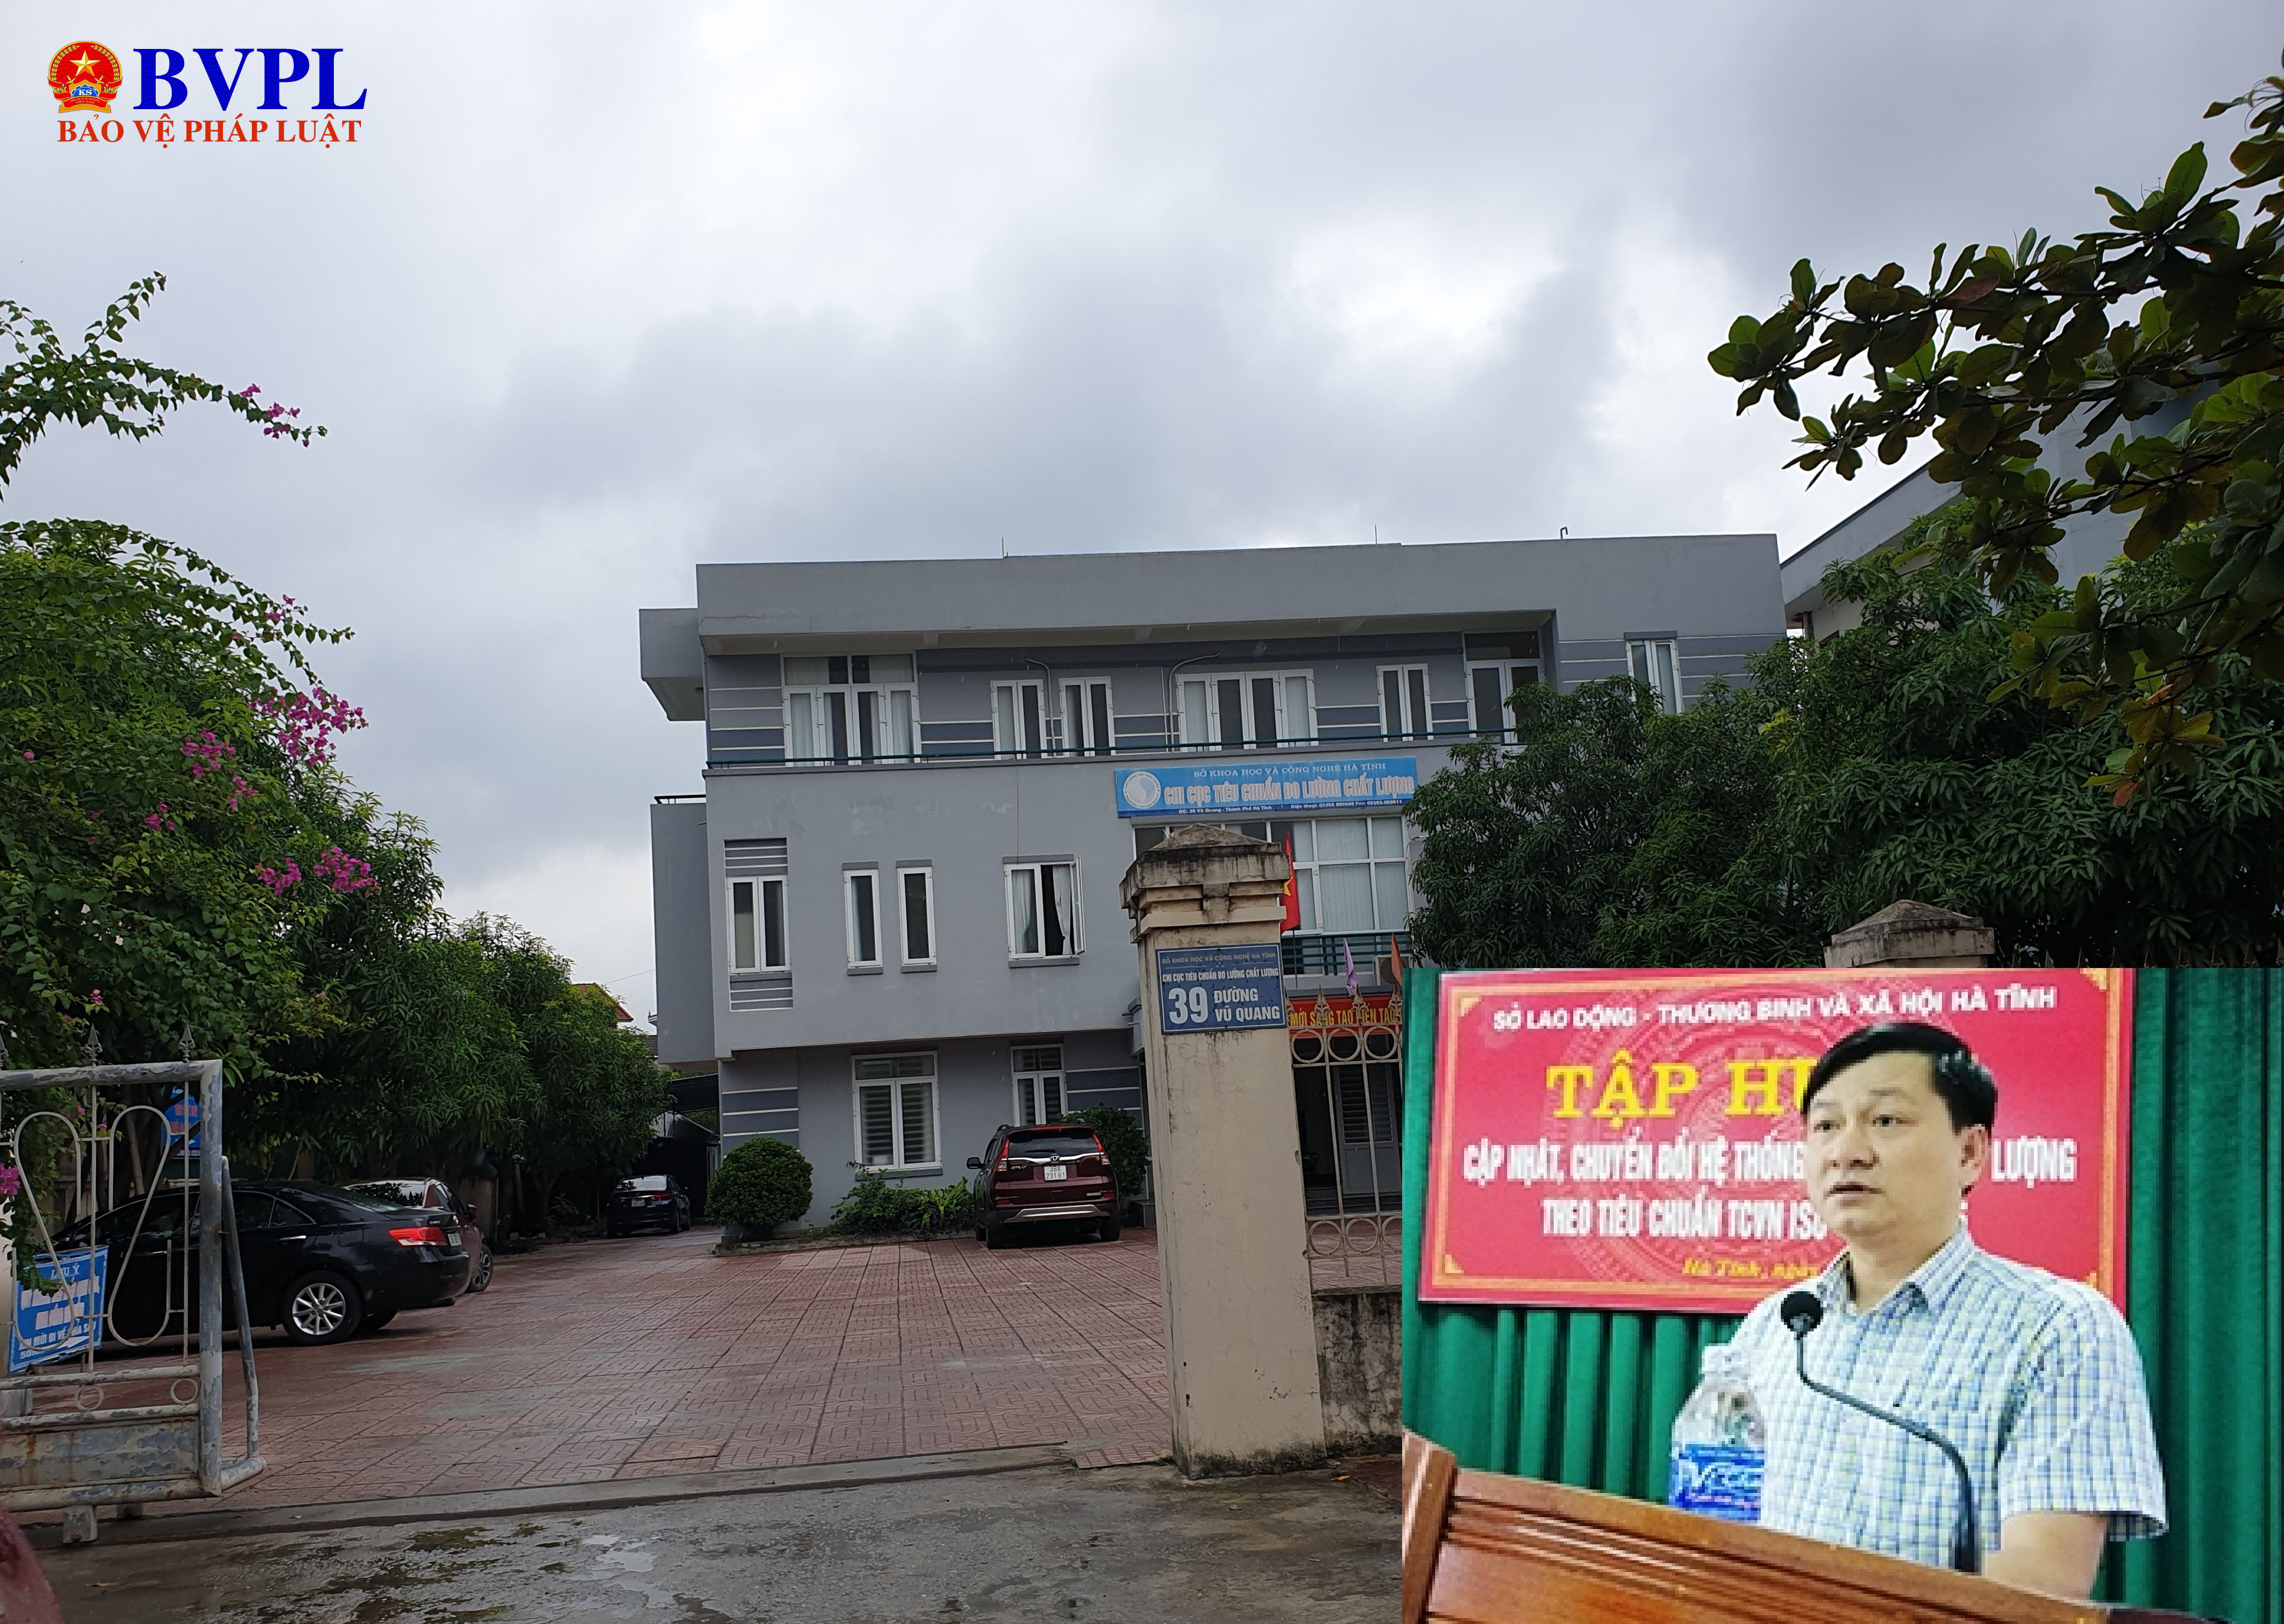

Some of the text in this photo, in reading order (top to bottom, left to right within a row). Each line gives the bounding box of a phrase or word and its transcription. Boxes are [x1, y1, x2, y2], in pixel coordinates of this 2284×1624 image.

[1193, 769, 1207, 777] SỞ
[1265, 765, 1279, 775] VÀ
[1281, 765, 1310, 773] CÔNG
[1312, 763, 1341, 772] NGHỆ
[1343, 762, 1358, 771] HÀ
[1164, 786, 1184, 805] CHI
[1187, 785, 1211, 808] CỤC
[1213, 780, 1239, 803] TIÊU
[1302, 776, 1341, 799] LƯỜNG
[1344, 772, 1373, 796] CHẤT
[1375, 776, 1415, 799] LƯỢNG
[1215, 953, 1232, 961] CÔNG
[1233, 952, 1251, 960] NGHỆ
[1162, 974, 1172, 982] CHI
[1173, 973, 1184, 983] CỤC
[1185, 971, 1197, 981] TIÊU
[1198, 967, 1217, 980] CHUẨN
[1227, 968, 1245, 979] LƯỜNG
[1246, 966, 1260, 978] CHẤT
[1261, 967, 1279, 977] LƯỢNG
[1168, 986, 1209, 1024] 39
[1214, 986, 1258, 1003] ĐƯỜNG
[1494, 1000, 1521, 1032] SỞ
[1526, 1010, 1568, 1029] LAO
[1658, 1000, 1751, 1024] THƯƠNG
[1757, 997, 1812, 1020] BINH
[1820, 992, 1850, 1017] VÀ
[1859, 989, 1893, 1015] XÃ
[1901, 990, 1943, 1017] HỘI
[1951, 985, 1988, 1012] HÀ
[1993, 983, 2058, 1010] TĨNH
[1215, 1005, 1280, 1022] VŨ QUANG
[1289, 1006, 1307, 1026] MỚI
[1546, 1047, 1699, 1130] TẬP
[1463, 1138, 1504, 1186] CẬP
[1694, 1136, 1729, 1187] HỆ
[1991, 1135, 2078, 1188] LƯỢNG
[1543, 1198, 1593, 1235] THEO
[1597, 1193, 1643, 1237] TIÊU
[1728, 1199, 1784, 1239] TCVN
